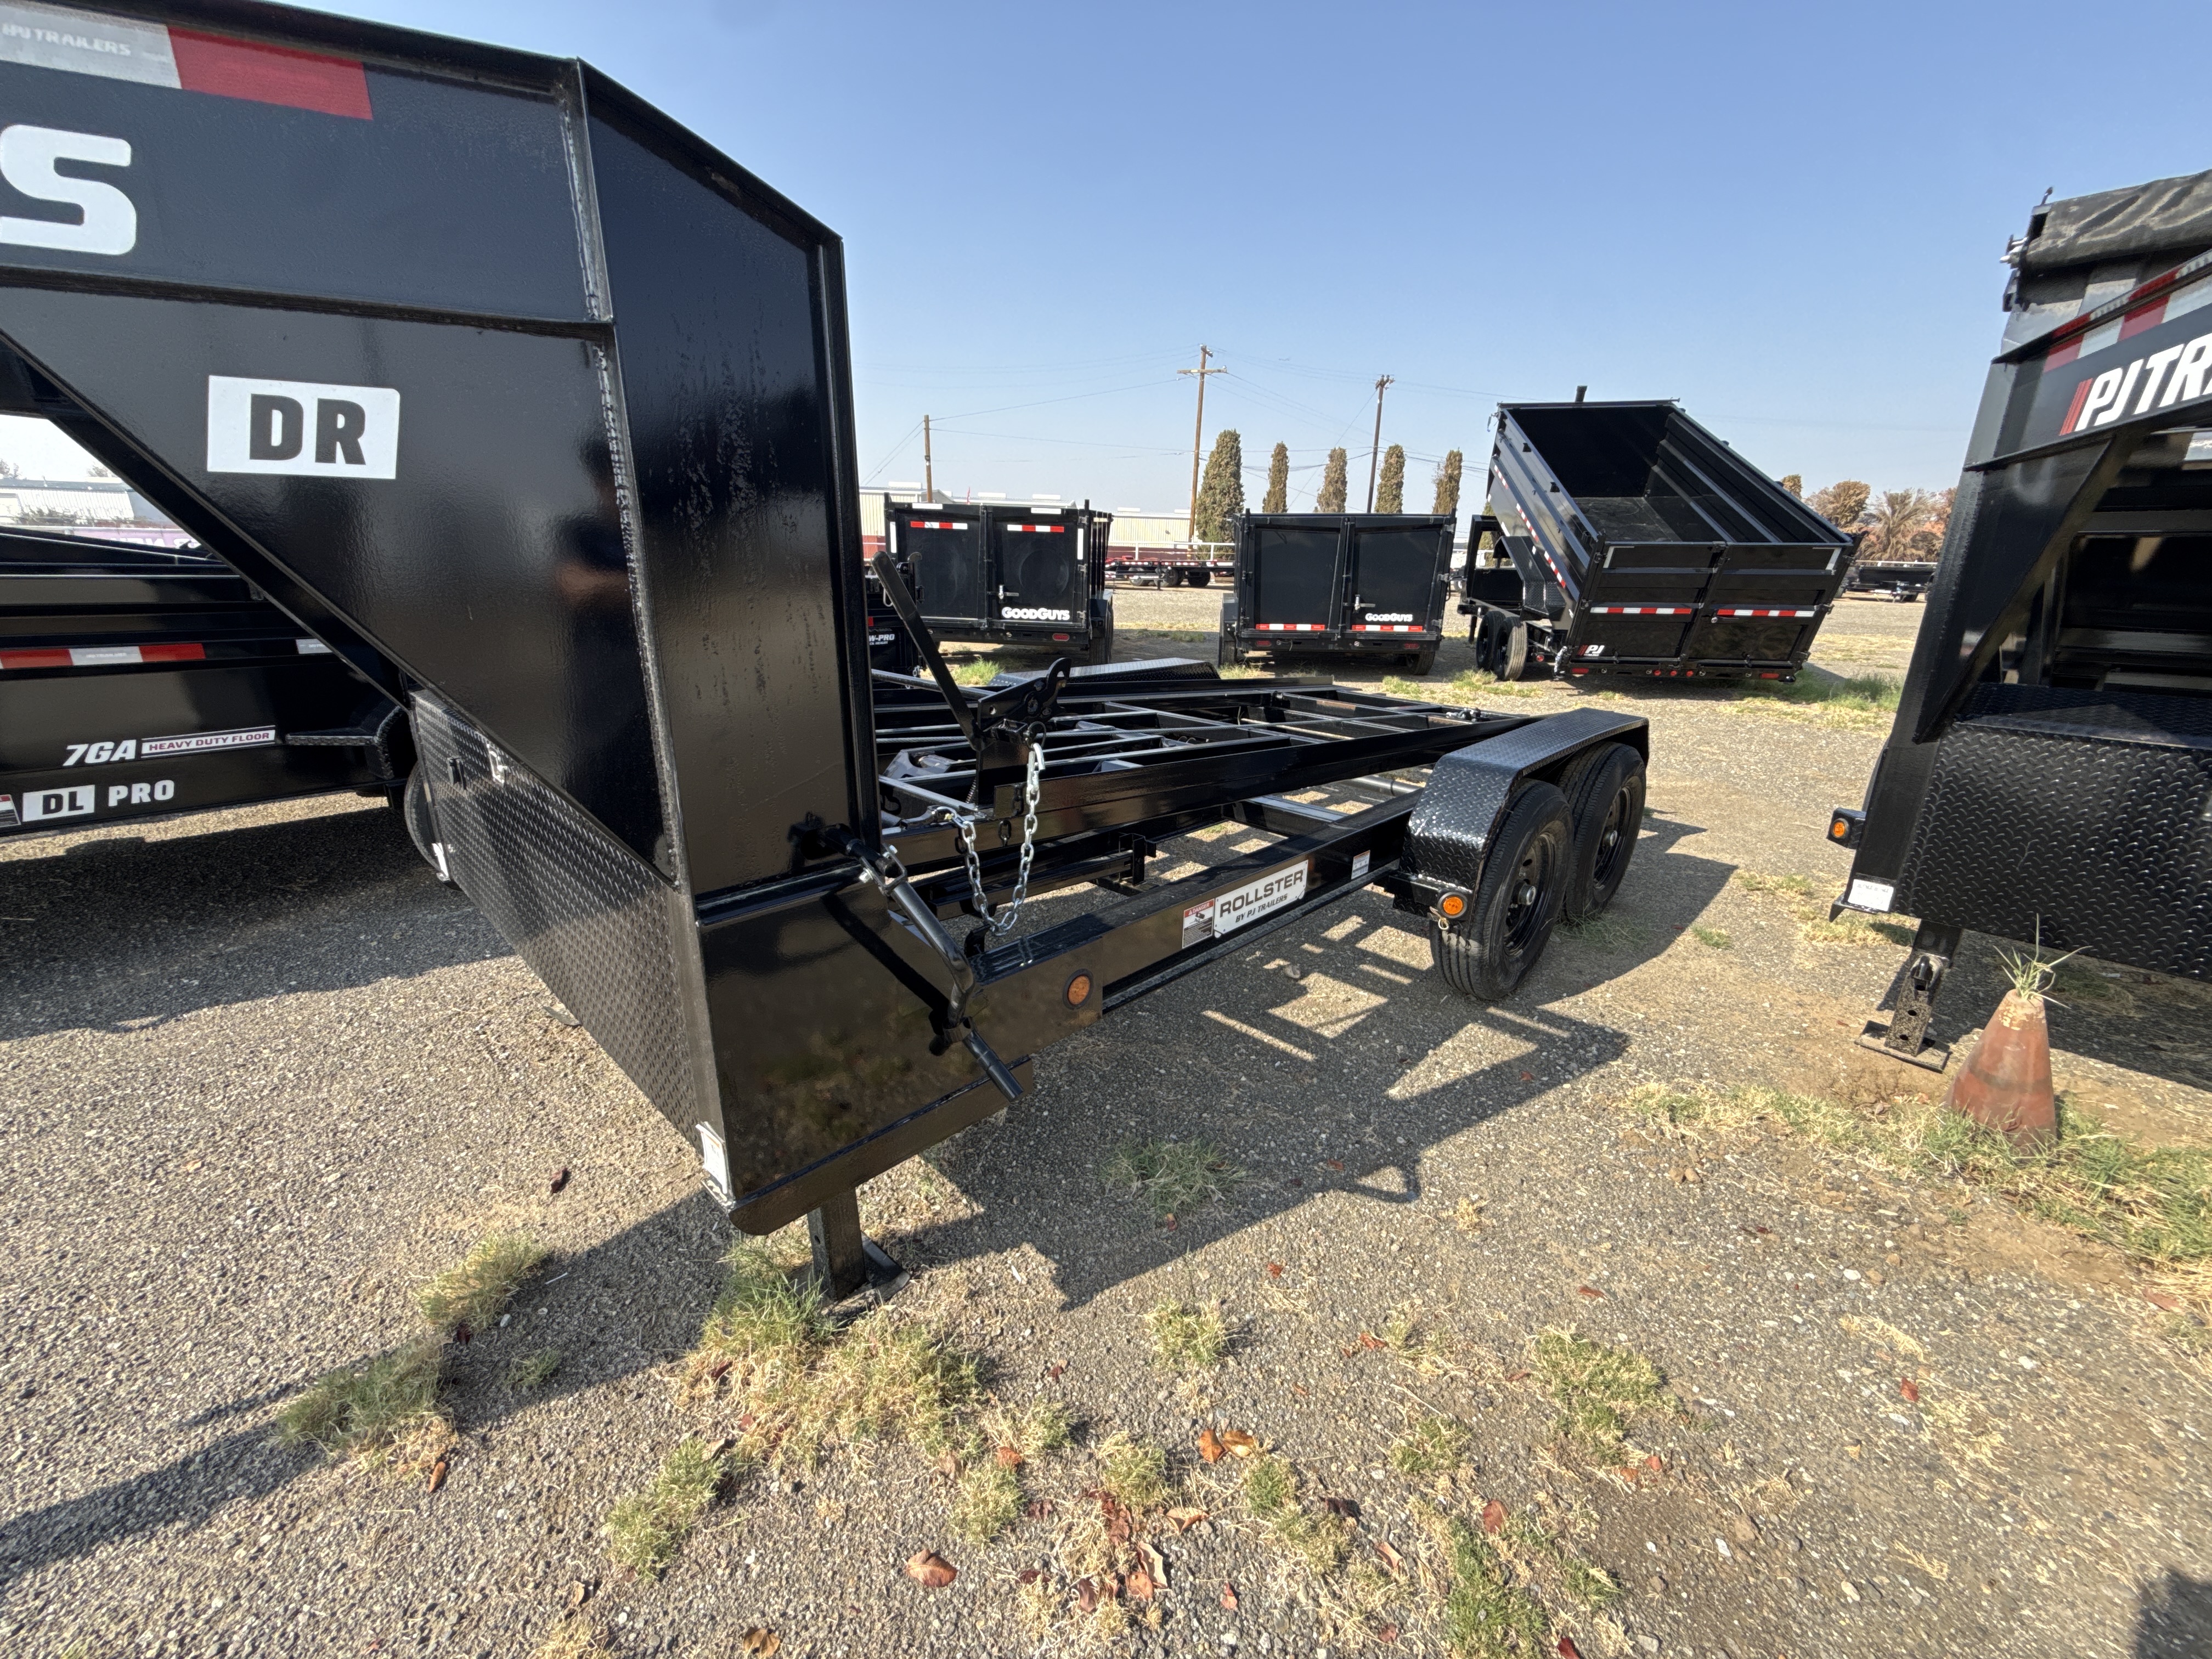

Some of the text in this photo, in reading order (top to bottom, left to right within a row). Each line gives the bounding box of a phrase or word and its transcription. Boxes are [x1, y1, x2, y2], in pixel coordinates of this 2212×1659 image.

[2074, 332, 2212, 432] PJTR
[249, 393, 366, 466] DR
[1585, 645, 1605, 654] PJ
[63, 732, 270, 766] 7GA HEAVY DUTY FLOOR
[42, 780, 175, 815] DL PRO
[1192, 902, 1210, 915] DANGER
[1220, 869, 1304, 918] ROLLSTER
[1235, 893, 1288, 923] BY PJ TRAILERS
